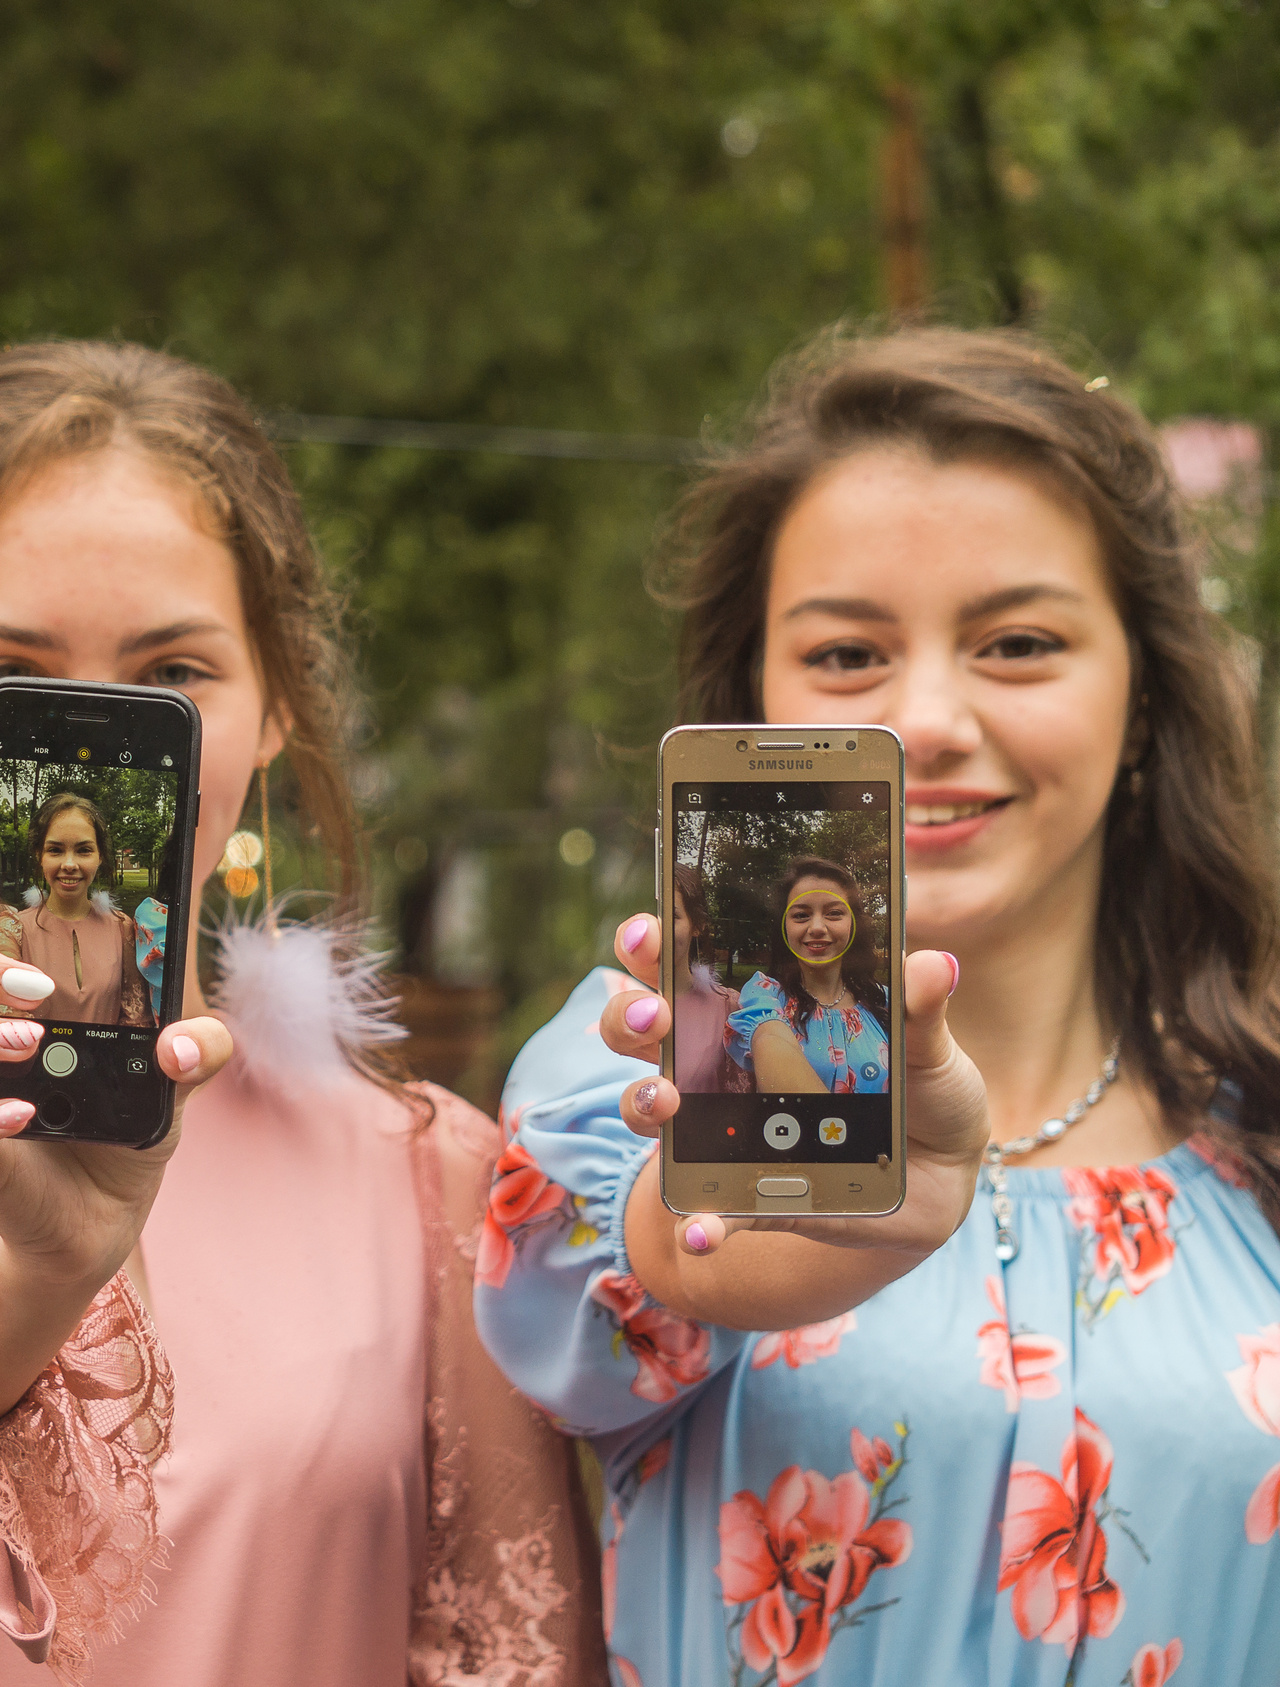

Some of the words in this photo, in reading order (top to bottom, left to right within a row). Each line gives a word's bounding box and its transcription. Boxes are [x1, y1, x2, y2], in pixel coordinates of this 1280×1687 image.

[748, 759, 813, 770] SAMSUNG
[51, 1027, 73, 1035] ФОТО
[85, 1030, 119, 1039] КВАДРАТ
